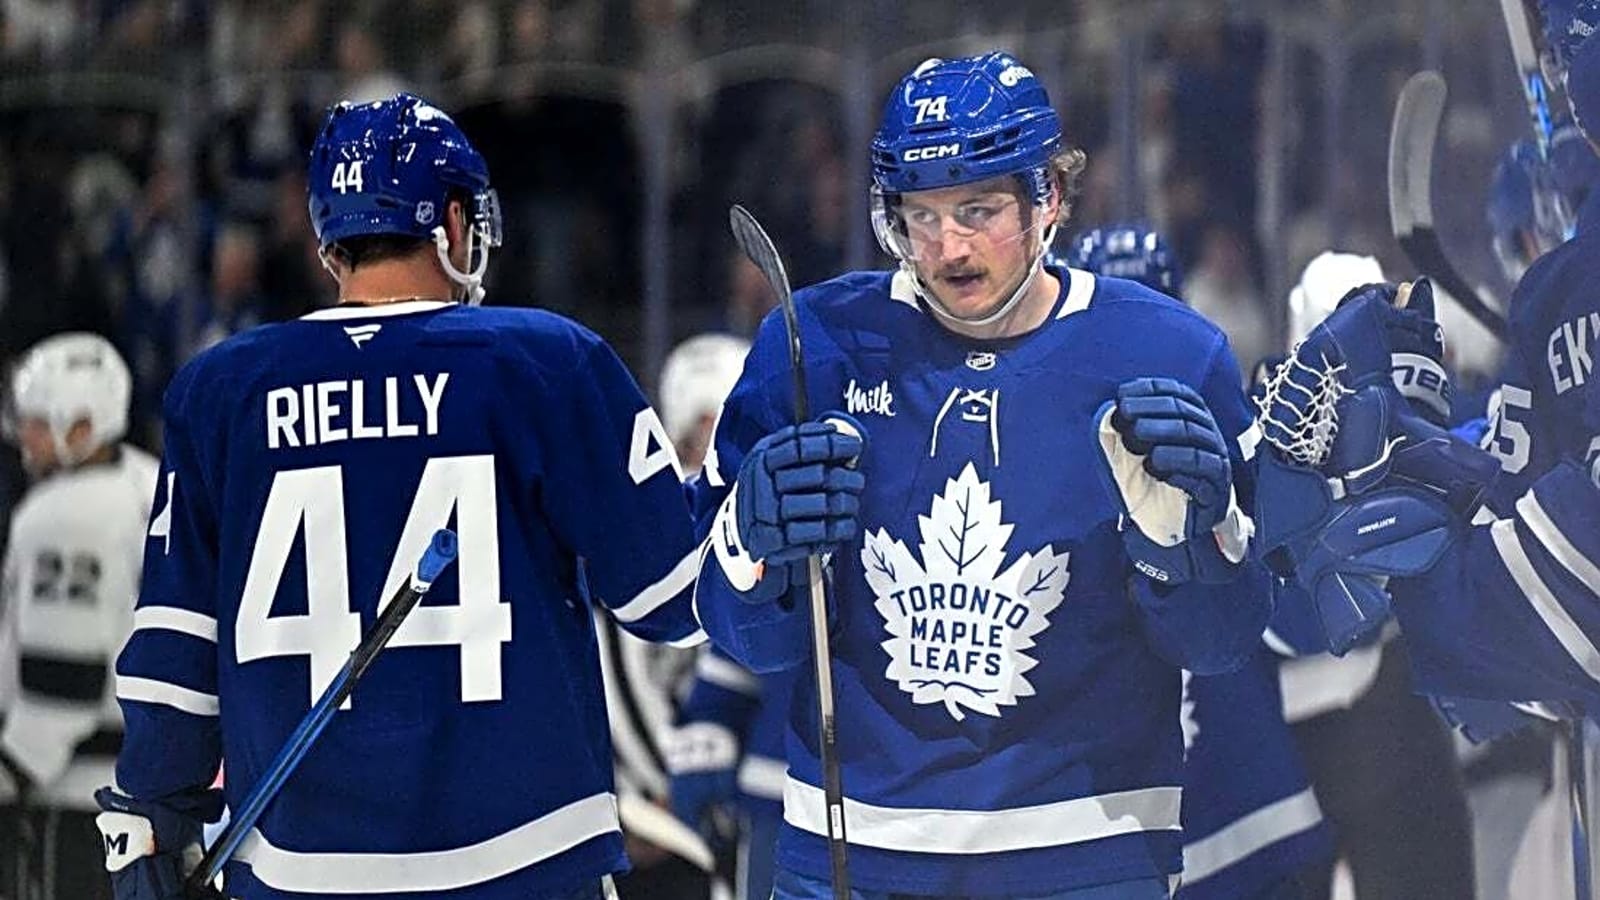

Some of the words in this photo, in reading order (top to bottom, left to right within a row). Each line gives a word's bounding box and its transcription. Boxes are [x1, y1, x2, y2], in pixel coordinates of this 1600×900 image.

[913, 95, 947, 124] 74
[903, 143, 961, 162] CCM
[331, 160, 364, 194] 44
[266, 372, 450, 449] RIELLY
[843, 378, 896, 417] Milk
[235, 454, 512, 711] 44
[890, 582, 1030, 630] TORONTO
[910, 616, 1004, 648] MAPLE
[910, 643, 1002, 676] LEAFS
